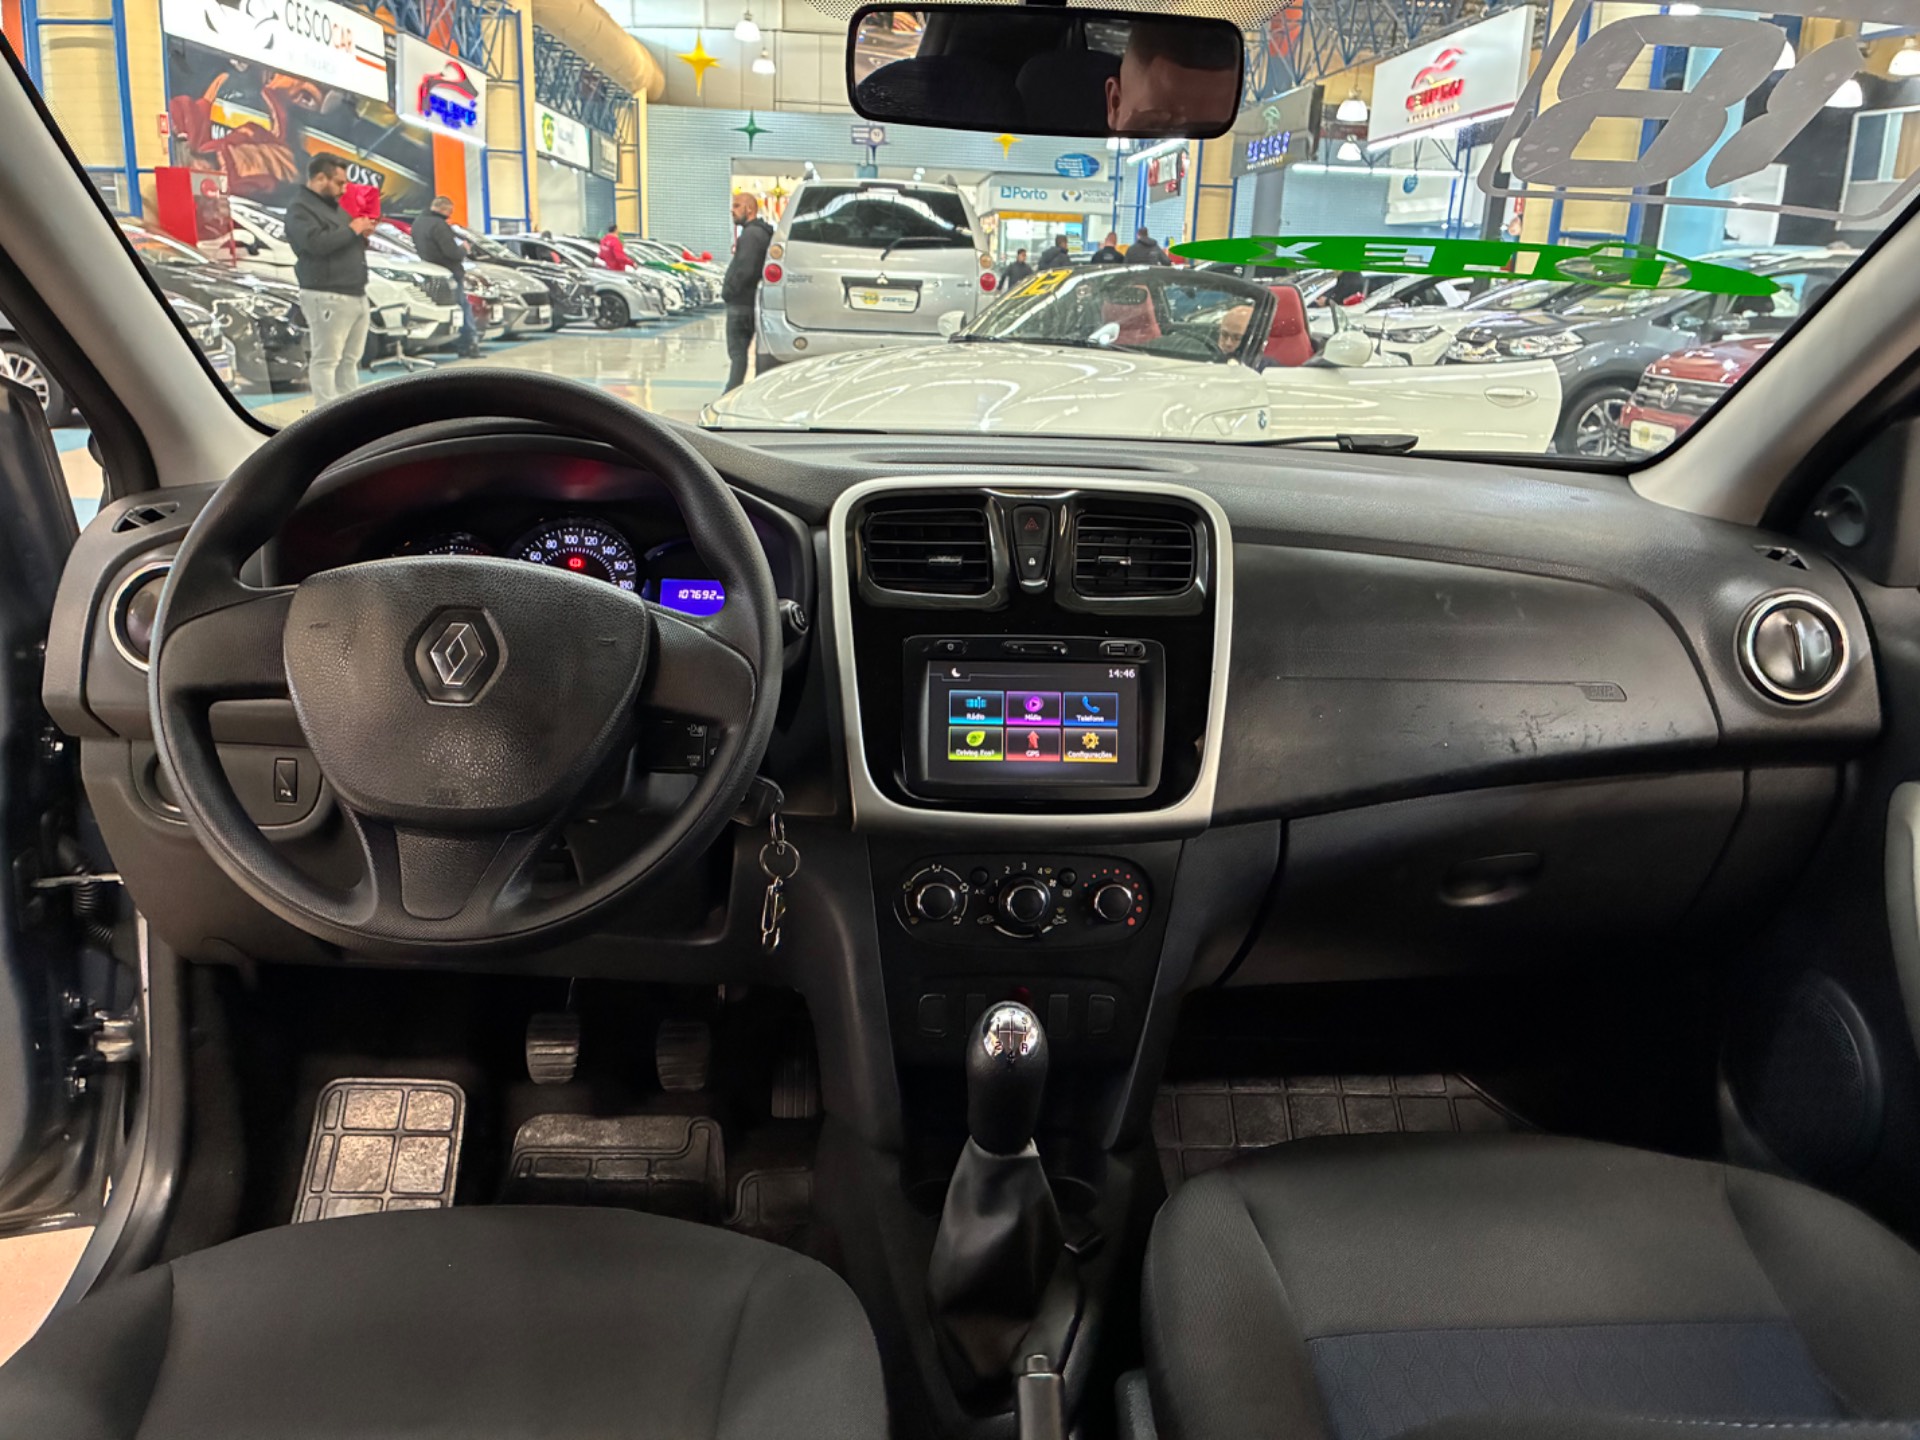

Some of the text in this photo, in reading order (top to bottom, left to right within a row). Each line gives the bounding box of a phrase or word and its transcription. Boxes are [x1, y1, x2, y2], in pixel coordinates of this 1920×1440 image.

[1012, 186, 1048, 200] Porto
[545, 540, 558, 549] 80
[564, 535, 579, 545] 100
[584, 536, 598, 546] 120
[601, 546, 617, 555] 140
[529, 551, 542, 561] 60
[613, 561, 629, 570] 160
[678, 589, 717, 600] 107692
[1108, 668, 1136, 678] 14:46
[1076, 714, 1105, 722] Telefone
[1025, 750, 1040, 758] GPS
[1005, 865, 1011, 875] 2
[1021, 861, 1027, 871] 3
[1037, 867, 1043, 875] 4
